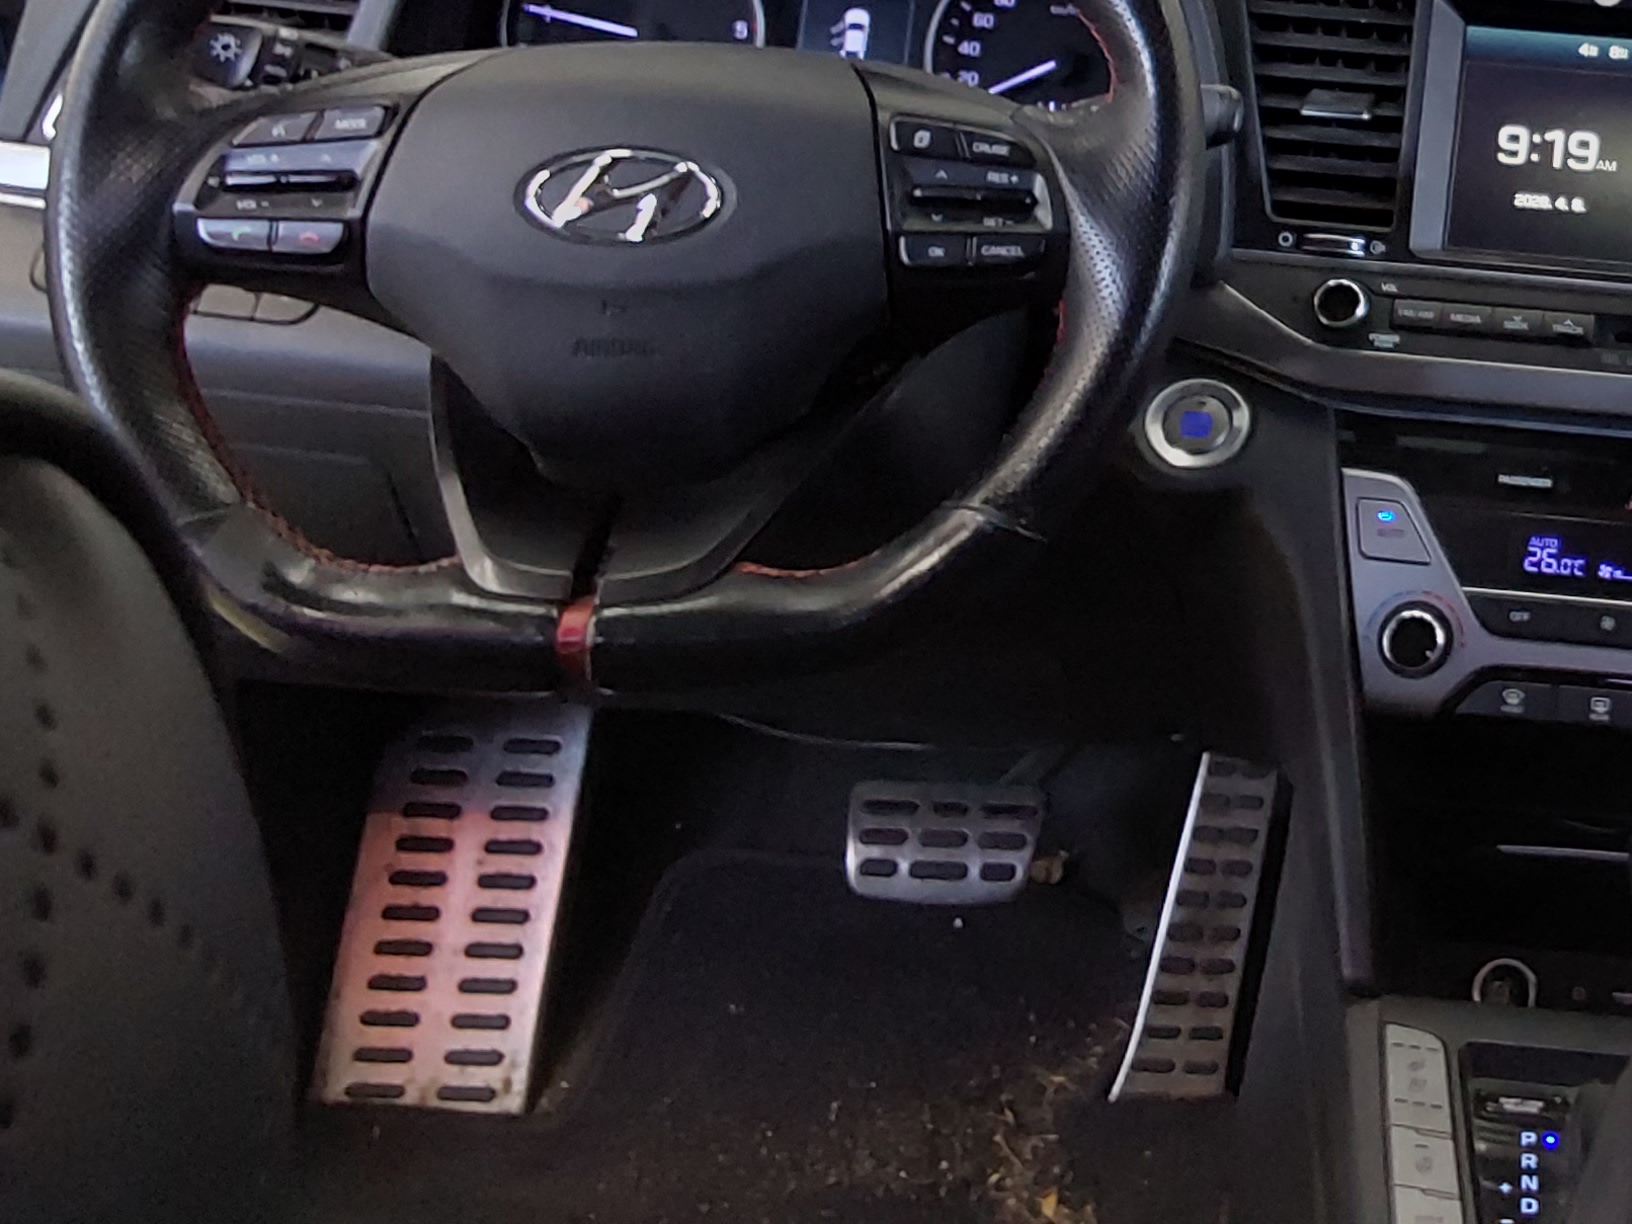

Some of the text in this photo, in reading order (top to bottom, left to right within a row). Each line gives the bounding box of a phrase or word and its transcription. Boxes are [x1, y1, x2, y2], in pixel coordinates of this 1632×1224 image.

[972, 12, 995, 29] 60
[957, 40, 981, 57] 40
[1450, 313, 1482, 323] MEDIA
[1529, 536, 1559, 548] AUTO
[1520, 1131, 1538, 1147] P
[1520, 1153, 1538, 1169] R
[1520, 1175, 1539, 1191] N
[1520, 1197, 1539, 1214] D
